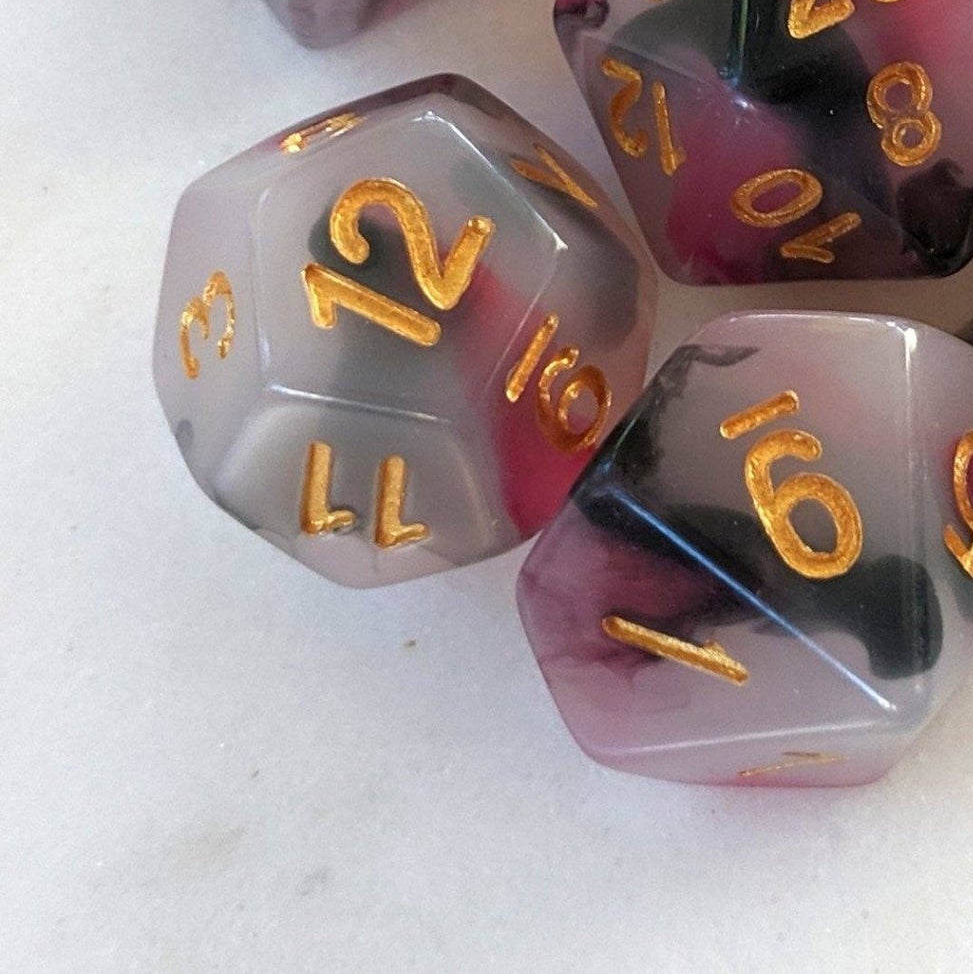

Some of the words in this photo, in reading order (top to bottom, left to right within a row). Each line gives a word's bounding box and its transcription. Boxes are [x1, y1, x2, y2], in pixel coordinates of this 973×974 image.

[602, 57, 686, 176] 12
[866, 61, 941, 167] 8
[301, 177, 496, 347] 12
[730, 168, 862, 264] 10
[179, 269, 235, 379] 3
[299, 440, 431, 549] 11
[602, 616, 750, 686] 1
